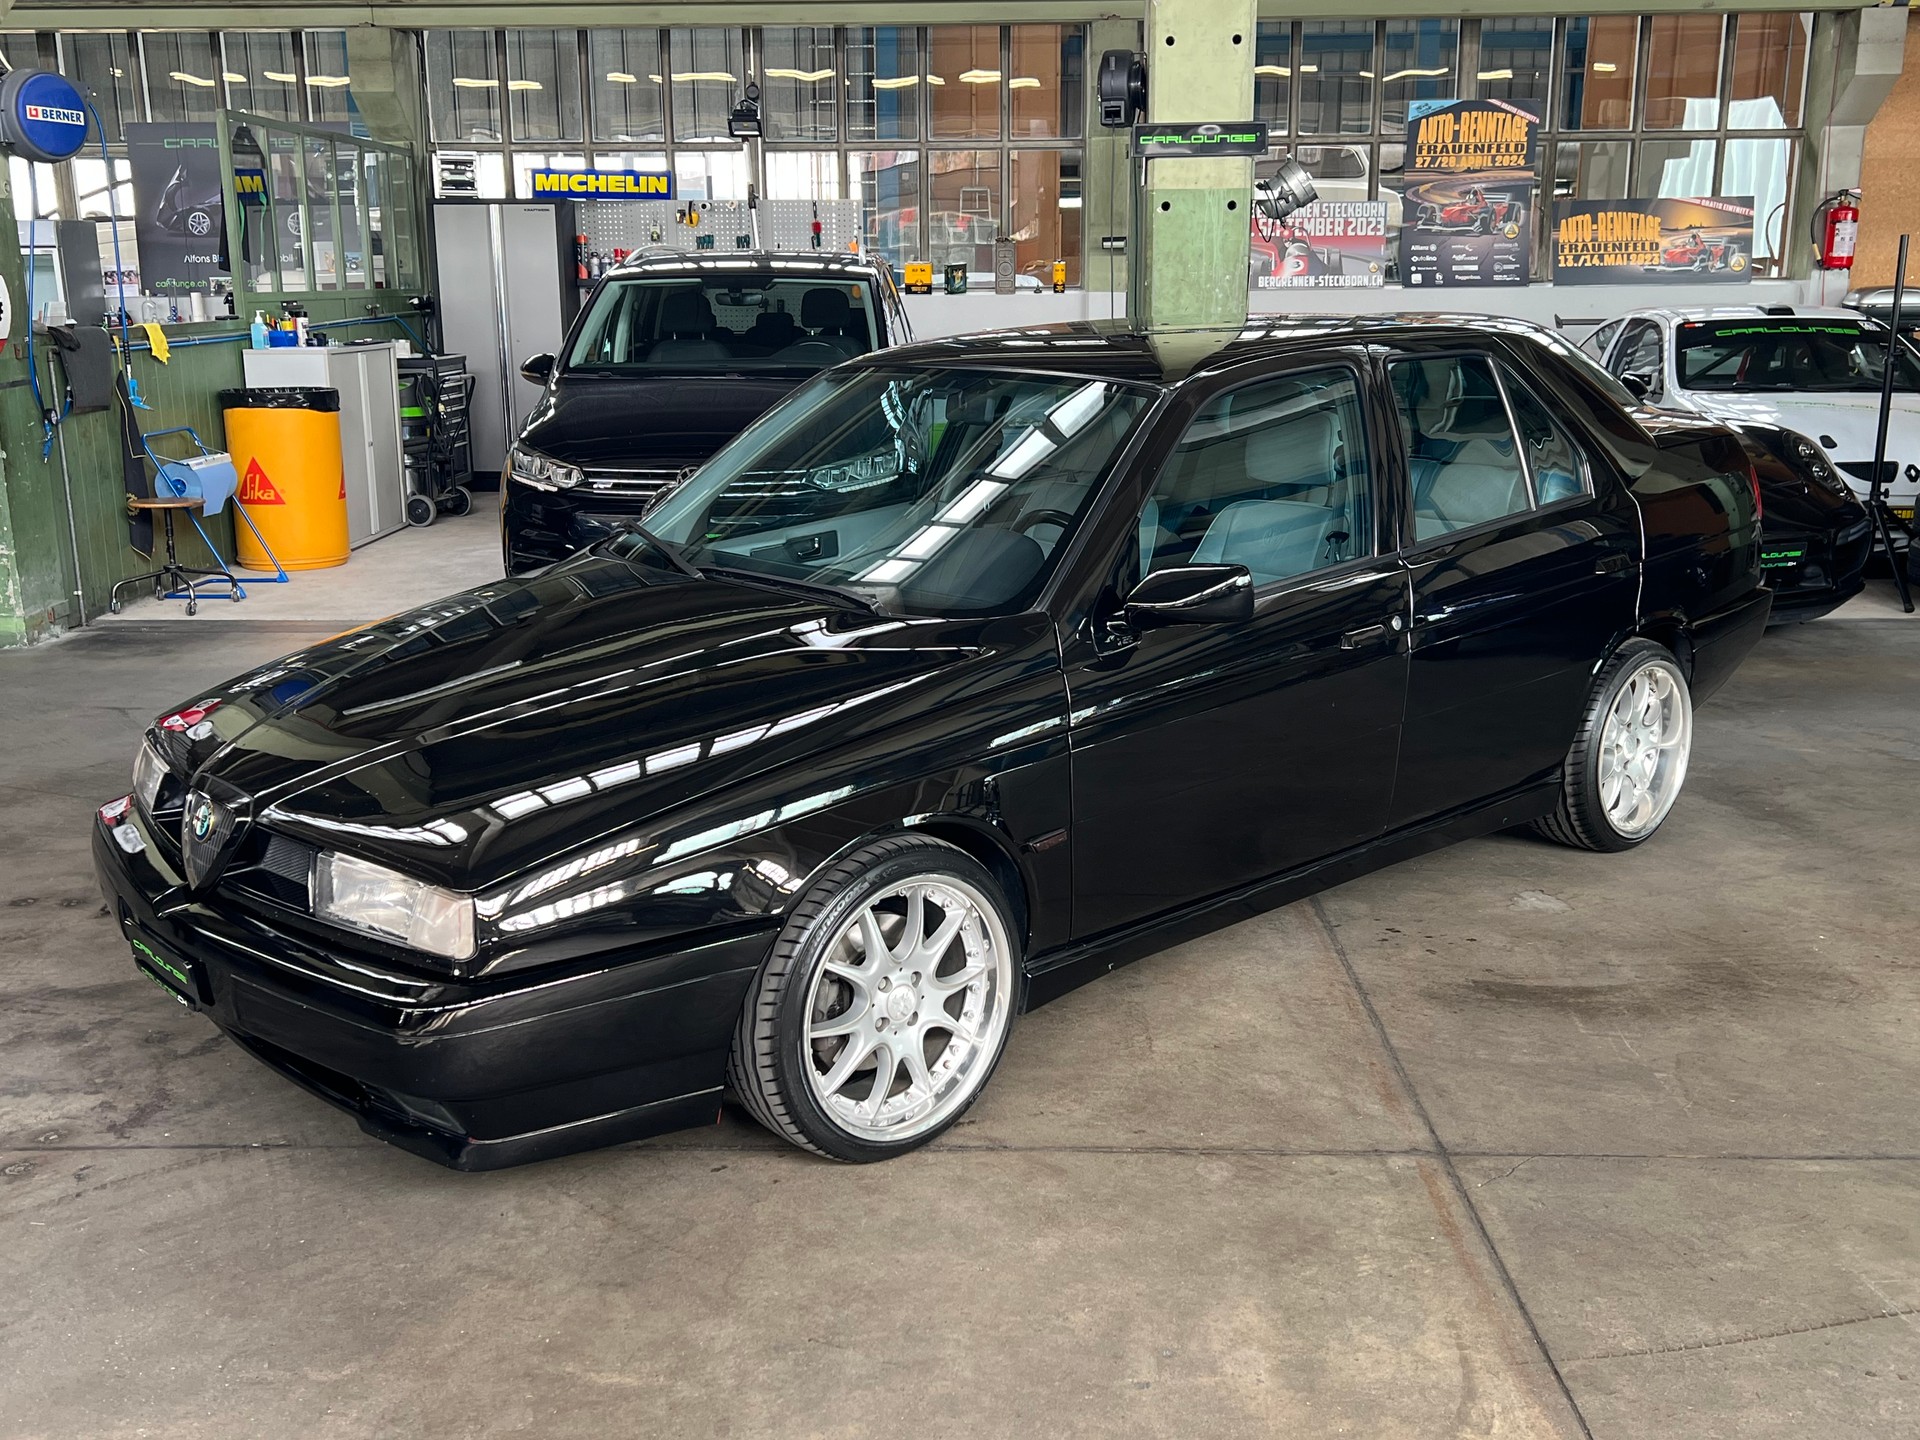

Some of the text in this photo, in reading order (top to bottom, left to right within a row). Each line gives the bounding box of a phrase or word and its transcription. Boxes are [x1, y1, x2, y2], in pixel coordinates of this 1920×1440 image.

[41, 108, 82, 124] BERNER
[1417, 111, 1529, 144] AUTO-RENNTAGE
[1140, 133, 1256, 145] CARLOUNGE
[1418, 143, 1525, 155] FRAUENFELD
[1494, 155, 1526, 166] 2024
[535, 174, 667, 193] MICHELIN
[1322, 202, 1384, 218] STECKBORN
[1346, 217, 1385, 236] 2023
[1559, 212, 1661, 243] AUTO-RENNTAGE
[1560, 242, 1660, 254] FRAUENFELD
[183, 254, 211, 264] Alfons
[1630, 254, 1660, 266] 2023
[1258, 275, 1384, 287] BERGRENNEN-STECKBORN.CH
[1715, 326, 1860, 337] CARLOUNGE
[242, 474, 276, 500] Sika
